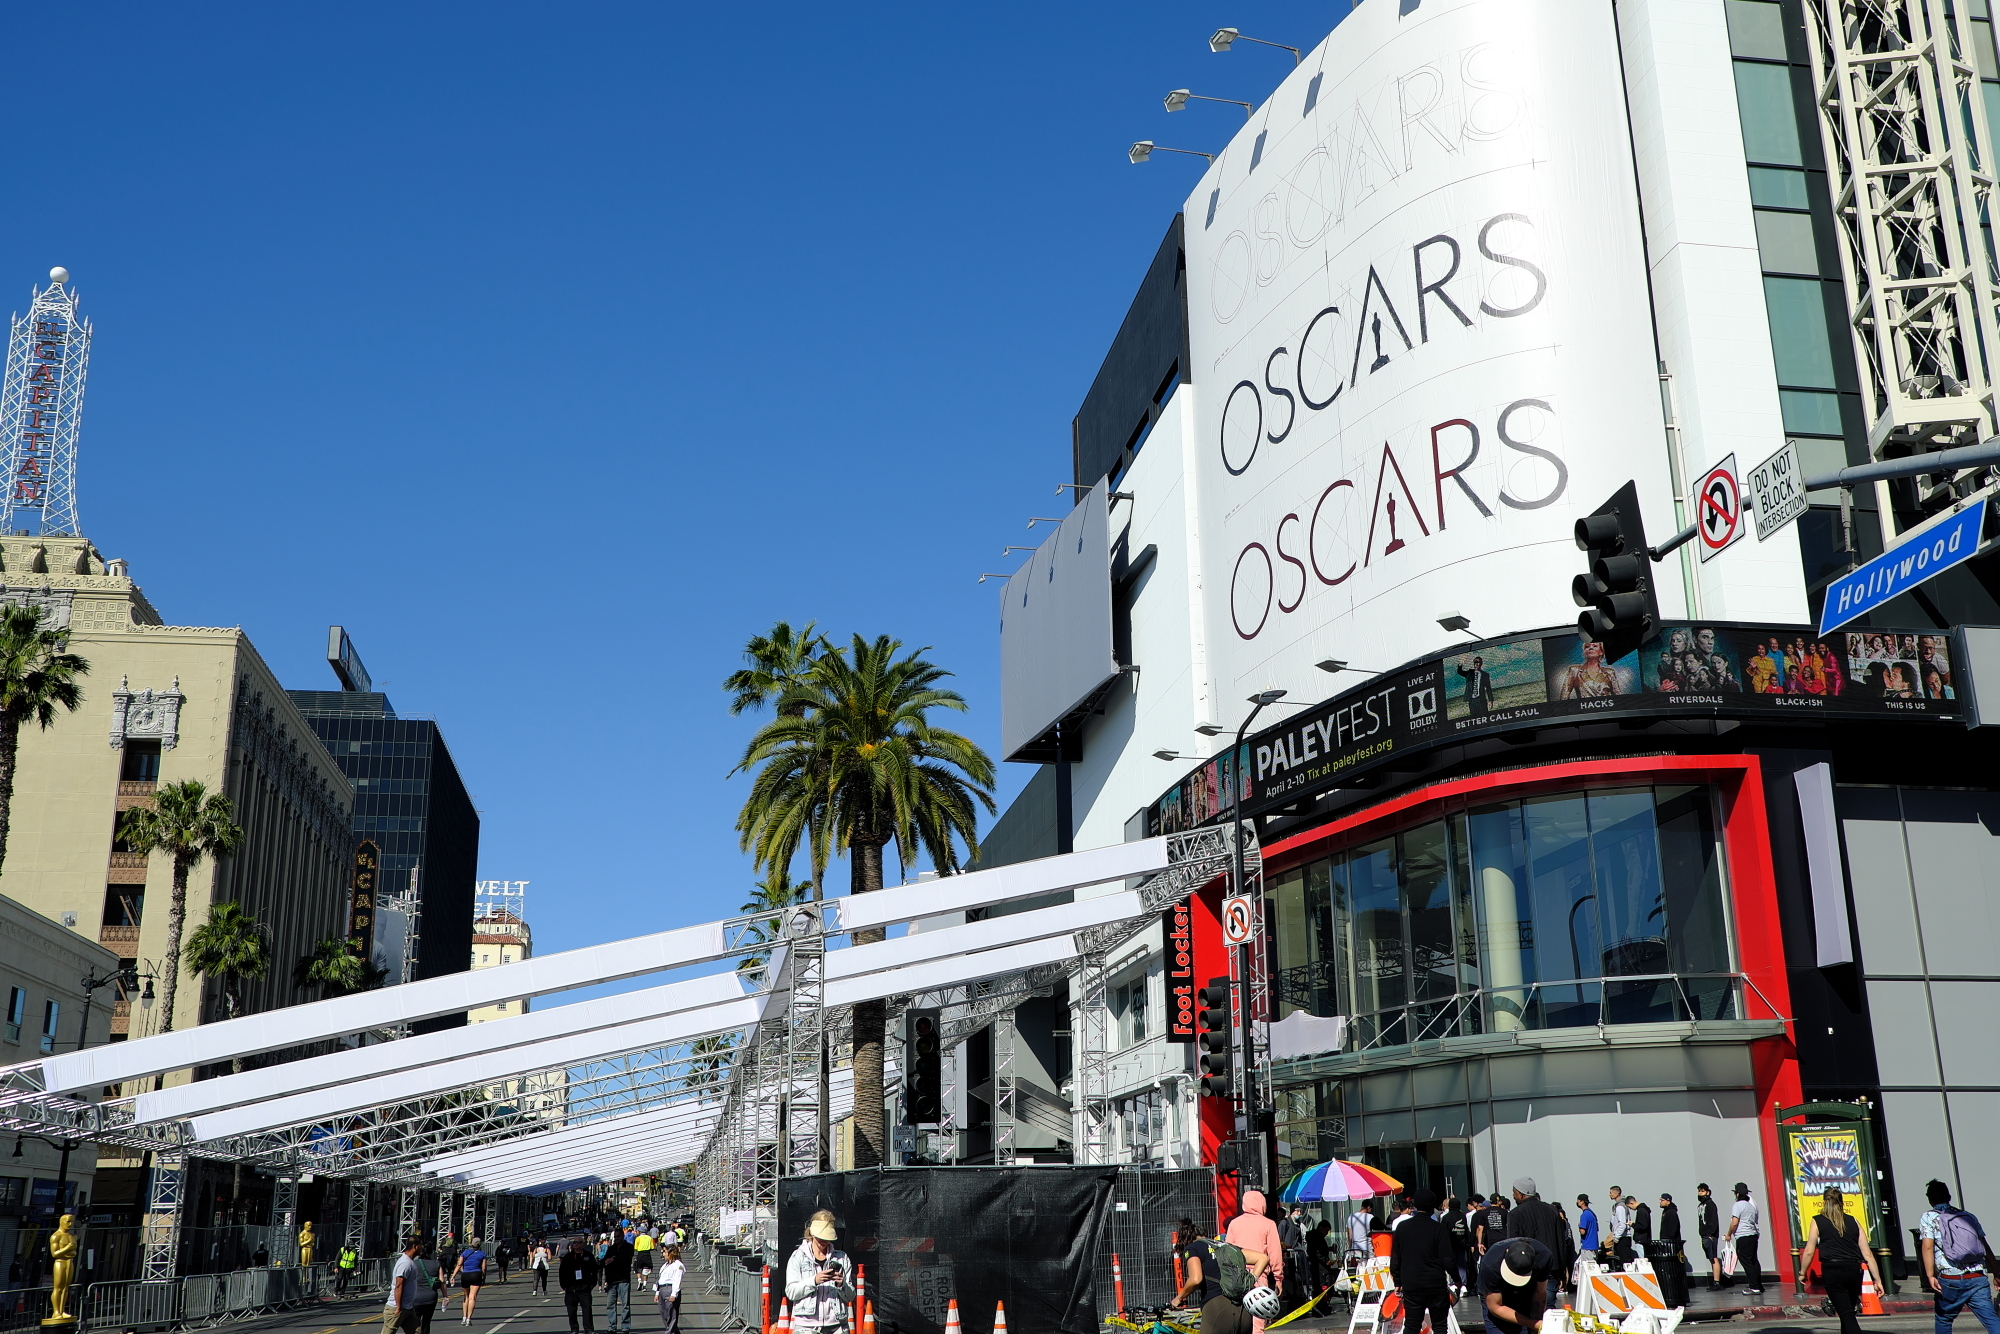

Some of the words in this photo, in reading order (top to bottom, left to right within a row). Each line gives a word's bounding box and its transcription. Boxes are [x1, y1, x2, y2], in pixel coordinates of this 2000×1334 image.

[1210, 41, 1529, 326] OSCARS
[35, 321, 62, 336] EL
[1220, 212, 1548, 476] OSCARS
[14, 341, 58, 500] CAPITAN
[1754, 469, 1770, 495] DO
[1771, 450, 1793, 478] NOT
[1757, 494, 1805, 536] INTERSECTION
[1760, 480, 1795, 514] BLOCK
[1230, 397, 1569, 641] OSCARS
[1837, 522, 1964, 615] Hollywood
[1407, 676, 1424, 688] LIVE
[1425, 672, 1435, 681] AT
[1455, 716, 1488, 730] BETTER
[1489, 712, 1513, 723] CALL
[1514, 707, 1540, 718] SAUL
[1580, 698, 1614, 710] HACKS
[1669, 695, 1724, 704] RIVERDALE
[1775, 697, 1824, 707] BLACK-ISH
[1885, 701, 1904, 709] THIS
[1914, 702, 1926, 710] US
[1256, 686, 1396, 782] PALEYFEST
[1409, 714, 1438, 730] DOLBY
[1265, 781, 1285, 799] April
[1306, 767, 1320, 781] Tix
[1321, 764, 1331, 775] at
[1333, 738, 1393, 773] paleyfest.org
[357, 853, 376, 870] EL
[354, 872, 373, 962] CAPI
[1170, 902, 1191, 978] Locker
[1173, 985, 1193, 1035] Foot
[1801, 1142, 1849, 1167] Hollywood
[1811, 1165, 1845, 1177] WAX
